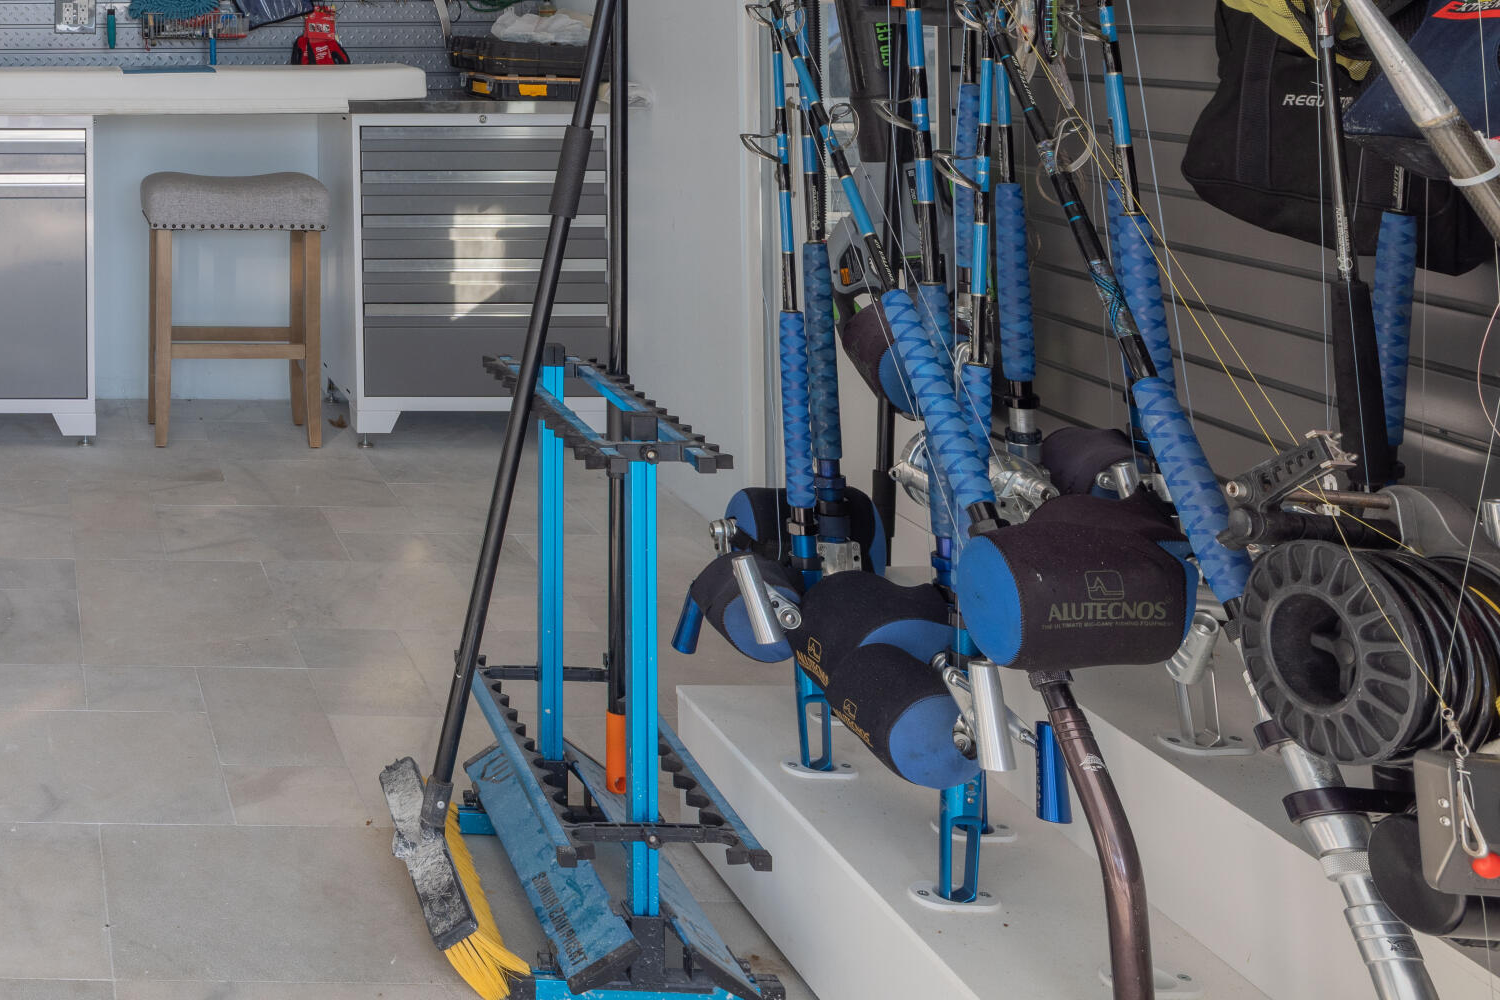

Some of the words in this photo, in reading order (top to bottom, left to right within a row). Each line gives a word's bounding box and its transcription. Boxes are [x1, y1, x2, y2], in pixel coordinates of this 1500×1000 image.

[1048, 601, 1167, 622] ALUTECNOS
[1054, 622, 1083, 630] ULTIMATE
[548, 903, 588, 967] EQUIPMENT
